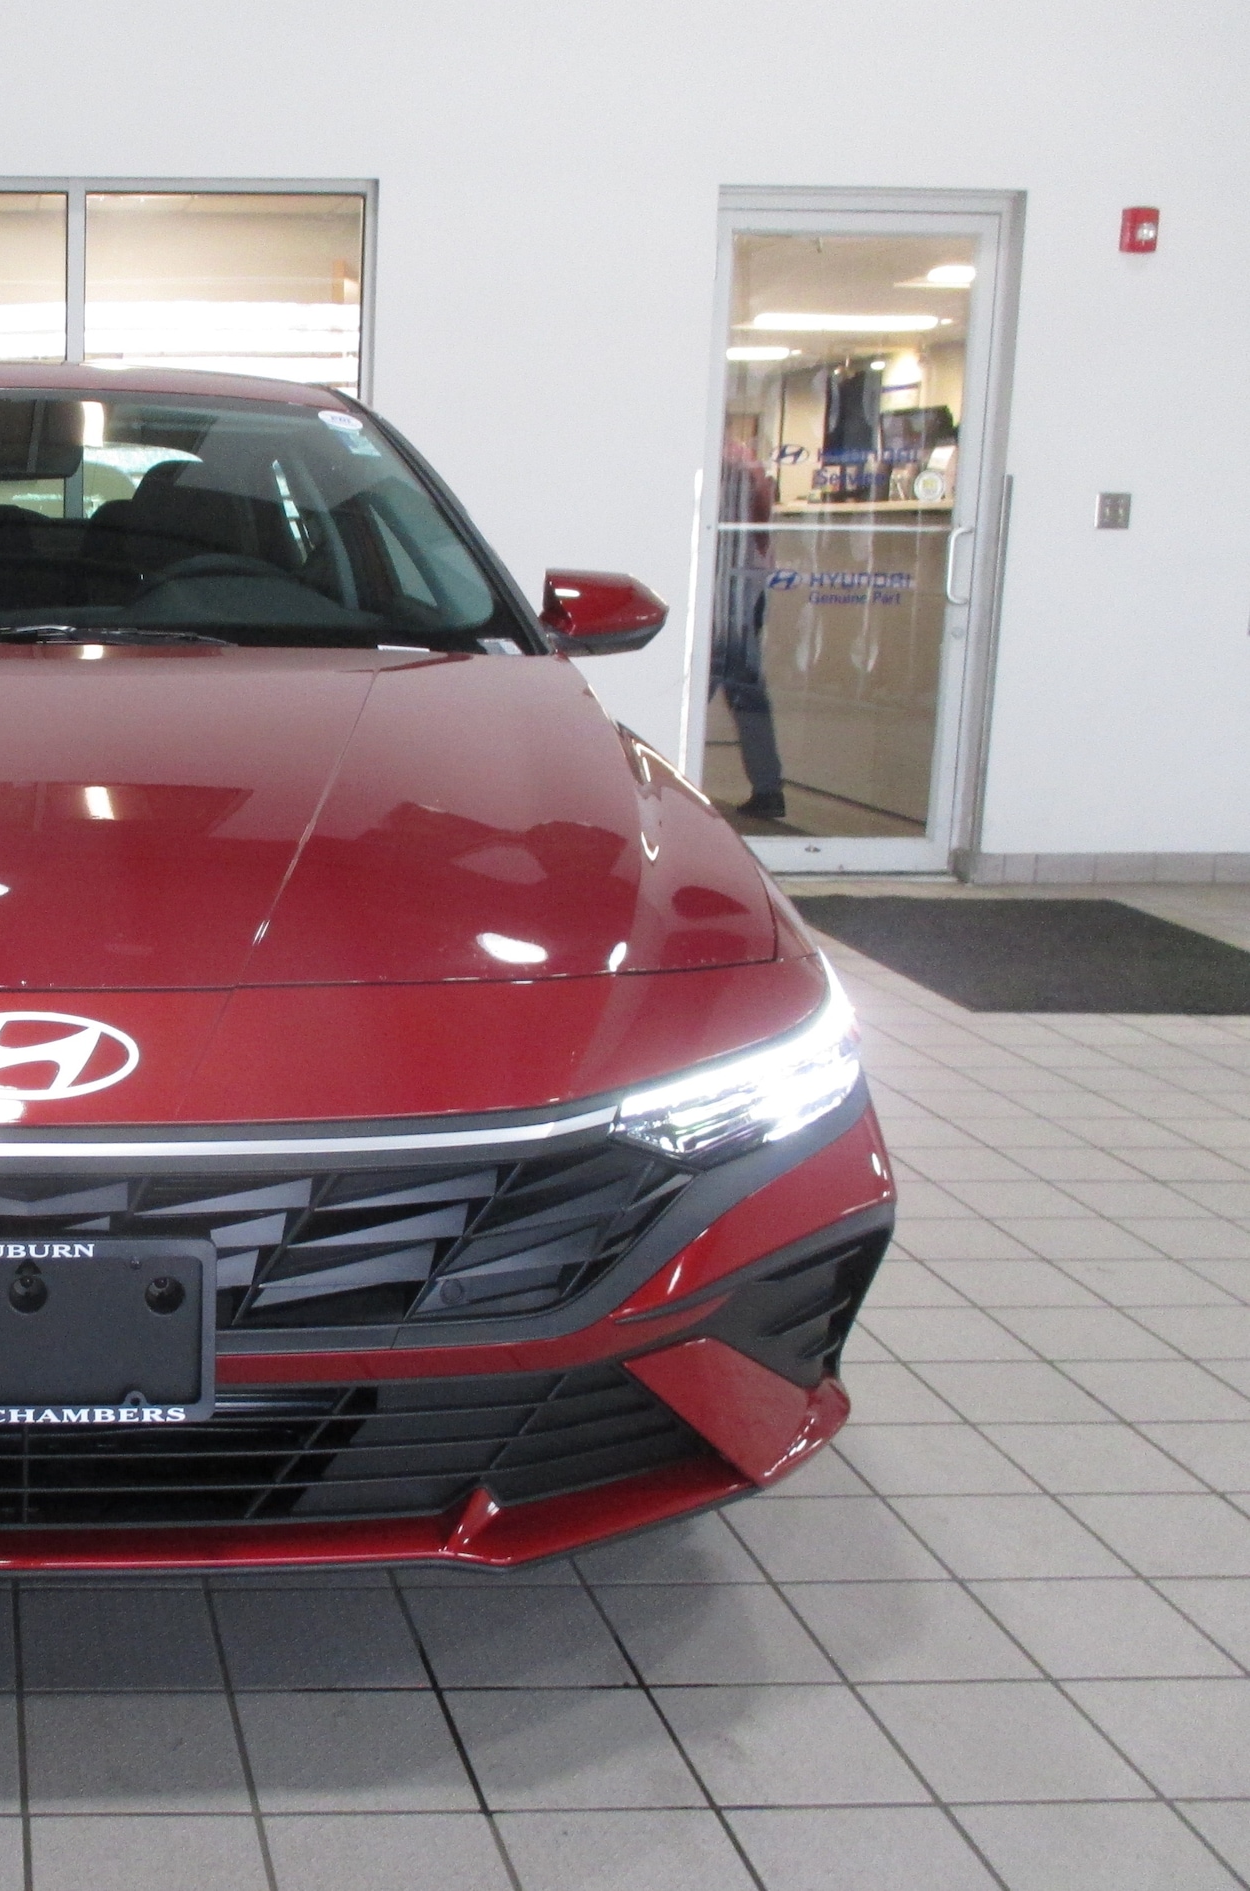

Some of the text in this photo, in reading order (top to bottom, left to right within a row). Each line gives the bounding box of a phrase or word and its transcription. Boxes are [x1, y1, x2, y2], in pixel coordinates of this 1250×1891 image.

[817, 447, 917, 464] HNDAI
[810, 572, 911, 589] HYUNDAI
[809, 590, 868, 605] Genuine
